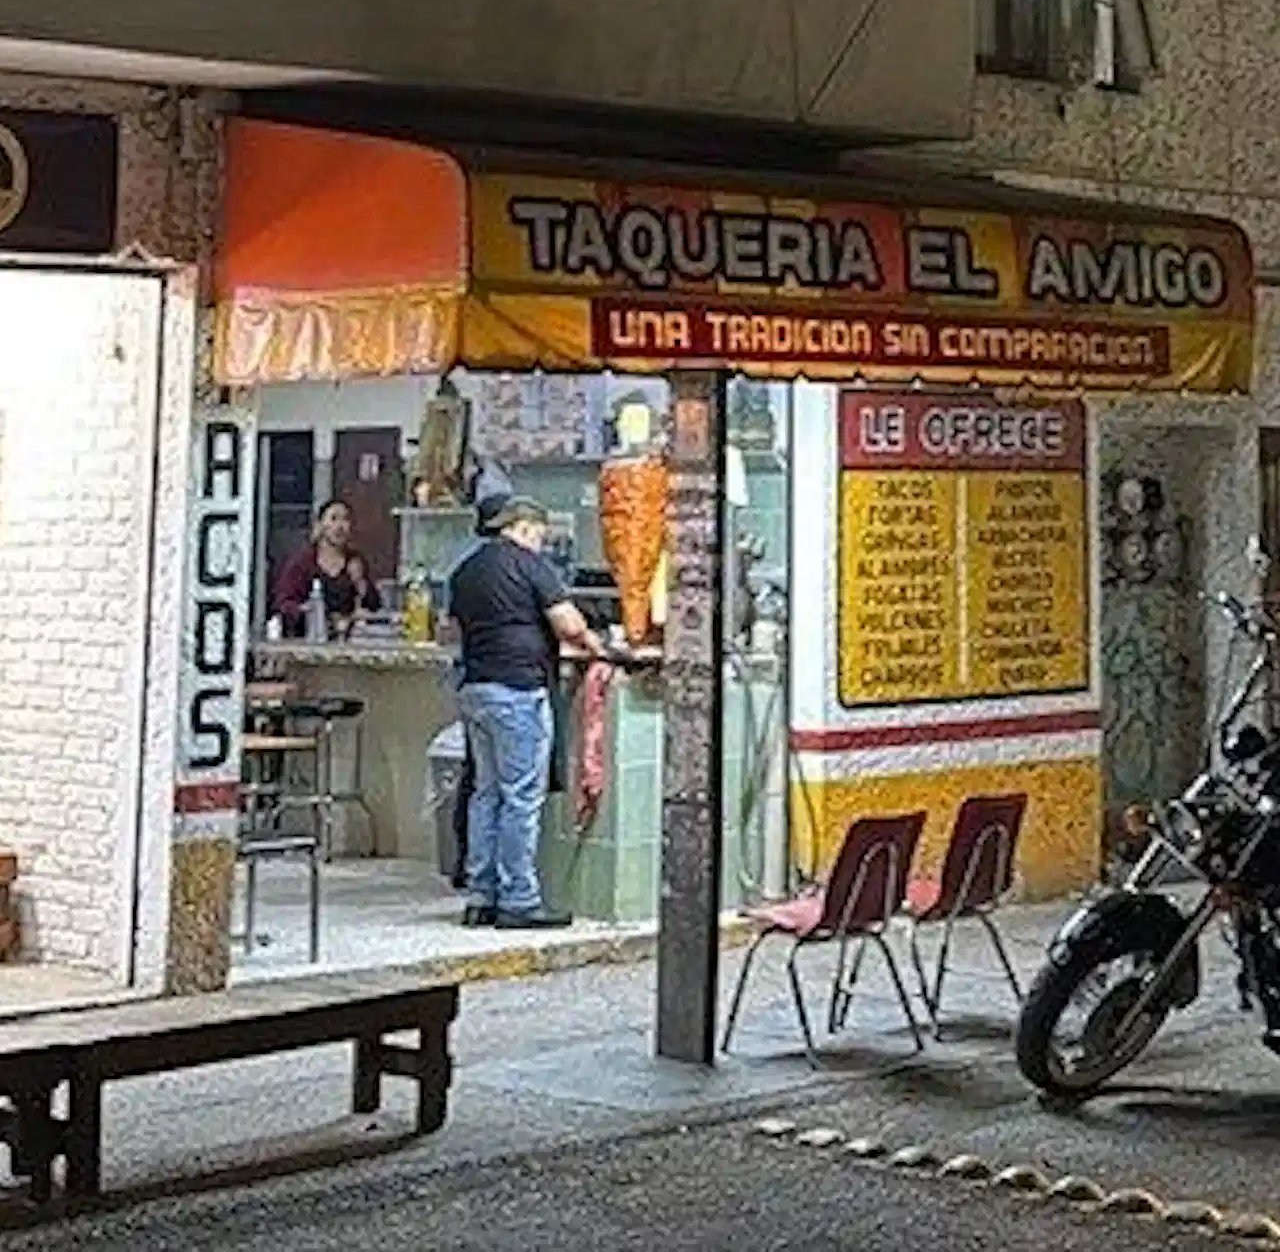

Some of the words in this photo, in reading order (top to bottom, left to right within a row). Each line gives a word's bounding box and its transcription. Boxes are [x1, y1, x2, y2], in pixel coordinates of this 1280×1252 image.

[510, 199, 884, 290] TAQUERIA
[906, 226, 998, 297] EL
[1027, 234, 1226, 308] AMIGO
[609, 309, 692, 349] UNA
[705, 314, 872, 356] TRADICION
[882, 322, 930, 360] SIN
[938, 325, 1157, 366] COMPARACION
[859, 404, 906, 454] LE
[918, 406, 1066, 458] OFRECE
[187, 422, 240, 770] ACOS
